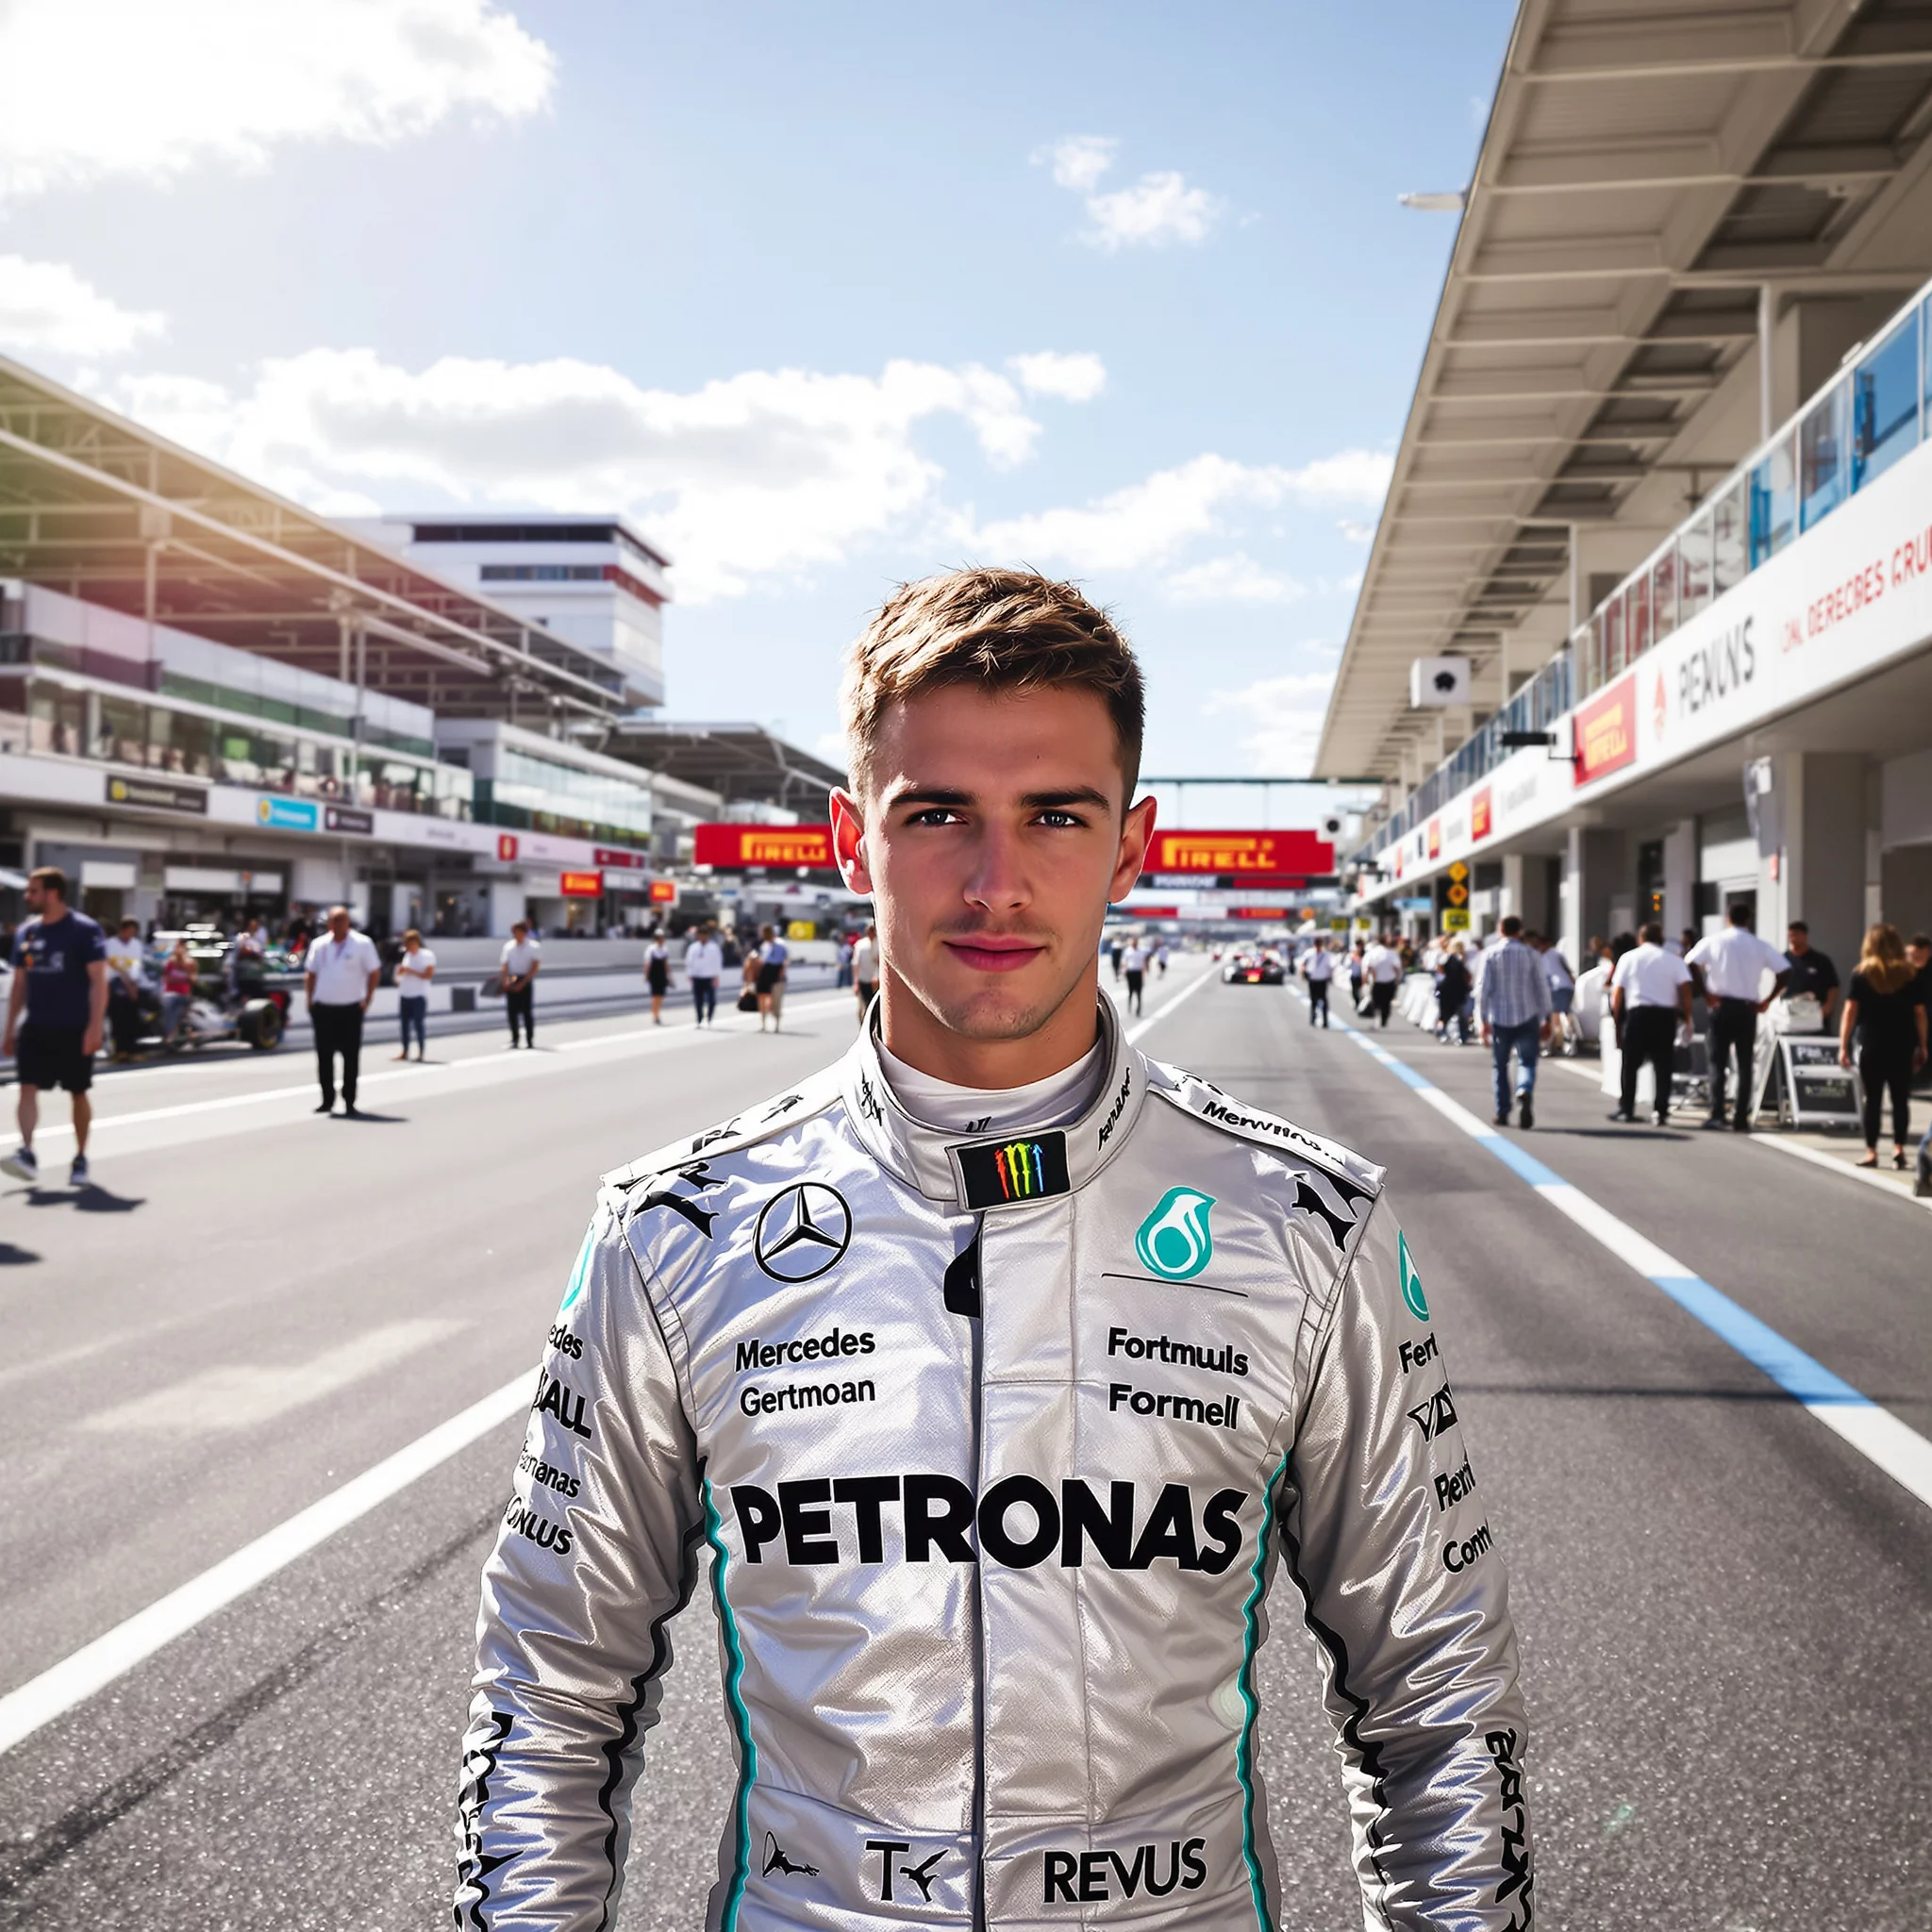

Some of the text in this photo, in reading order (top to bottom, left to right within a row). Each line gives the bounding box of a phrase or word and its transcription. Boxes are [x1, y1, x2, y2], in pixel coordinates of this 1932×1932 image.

[736, 1327, 875, 1372] Mercedes
[740, 1380, 875, 1416] Gertmoan
[1108, 1383, 1240, 1429] Formell
[730, 1474, 1249, 1574] PETRONAS
[1043, 1838, 1207, 1903] REVUS
